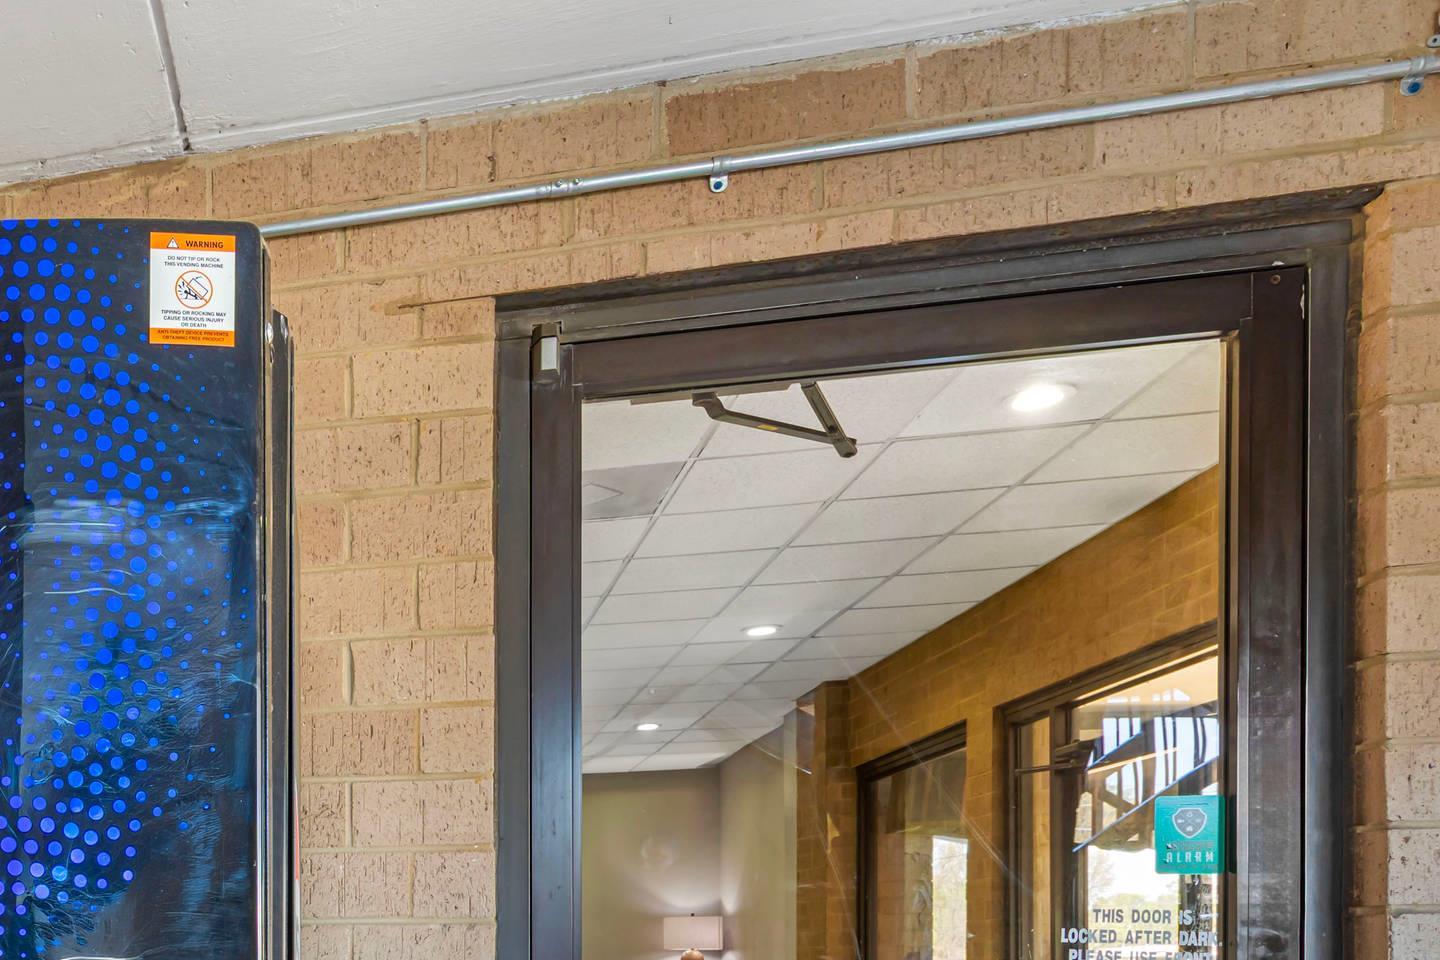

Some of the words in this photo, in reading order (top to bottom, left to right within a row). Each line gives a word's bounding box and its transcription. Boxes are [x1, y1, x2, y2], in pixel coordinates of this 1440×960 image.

[1166, 852, 1214, 863] ALARM
[1093, 909, 1124, 923] THIS
[1131, 910, 1171, 923] DOOR
[1179, 911, 1193, 925] IS
[1061, 928, 1117, 943] LOCKED
[1125, 930, 1172, 944] AFTER
